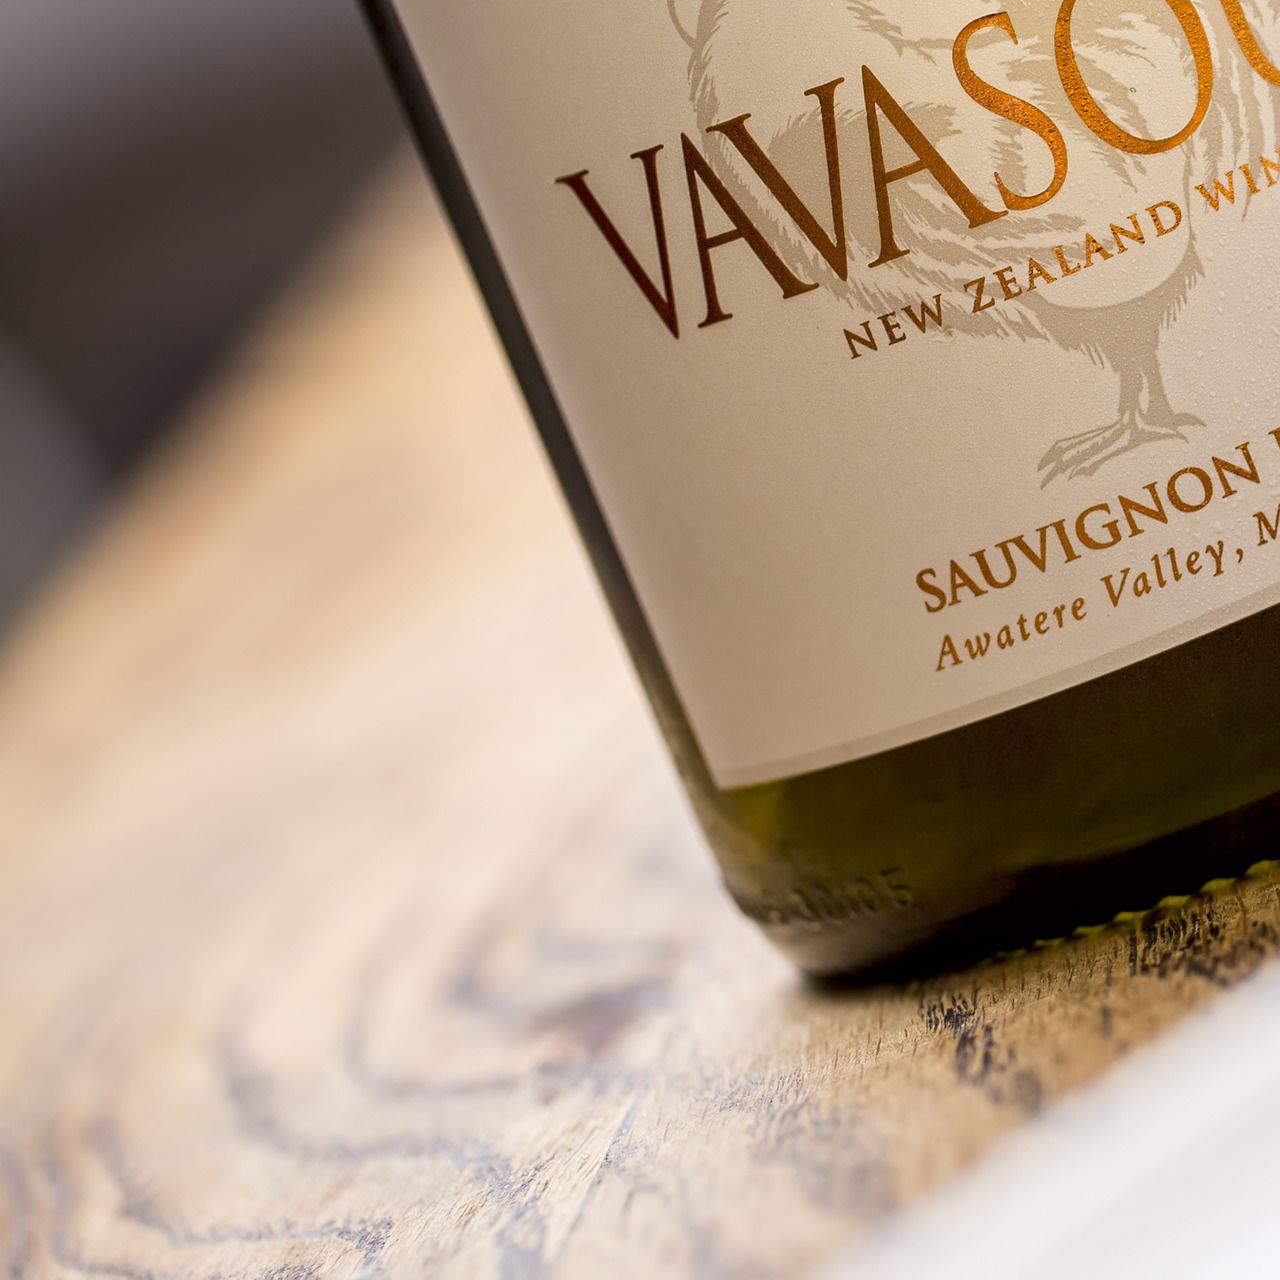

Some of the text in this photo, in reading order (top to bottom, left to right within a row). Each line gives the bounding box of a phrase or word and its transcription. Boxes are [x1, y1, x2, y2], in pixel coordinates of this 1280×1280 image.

[843, 294, 946, 359] NEW
[964, 200, 1184, 315] ZEALAND
[914, 443, 1262, 615] SAUVIGNON
[934, 586, 1088, 673] Awatere
[1103, 542, 1245, 608] Valley,
